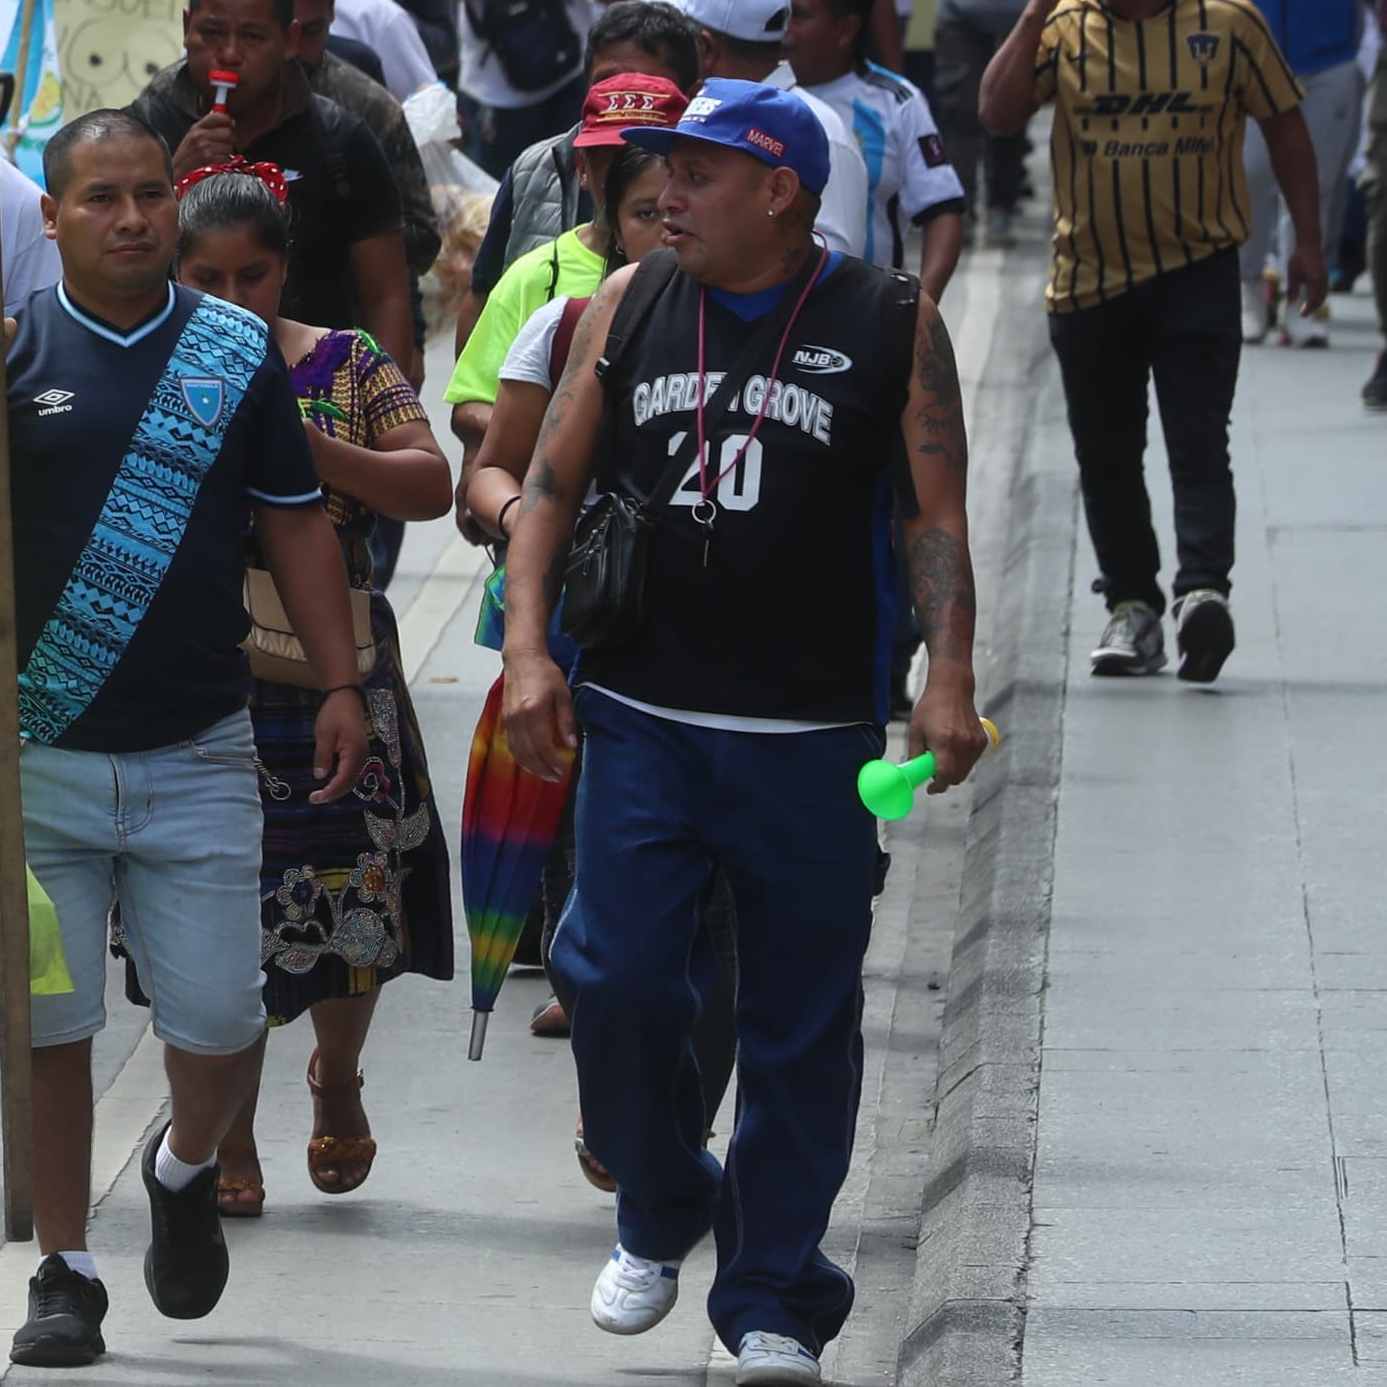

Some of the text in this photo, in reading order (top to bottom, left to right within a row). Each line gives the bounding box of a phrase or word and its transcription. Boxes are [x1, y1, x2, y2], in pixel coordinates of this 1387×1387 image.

[1093, 92, 1197, 115] DHL
[746, 128, 784, 158] MARVEL
[1103, 140, 1170, 157] Banca
[792, 349, 833, 365] NJB
[38, 404, 73, 417] umbro
[742, 374, 835, 447] GROVE
[667, 430, 764, 512] 20
